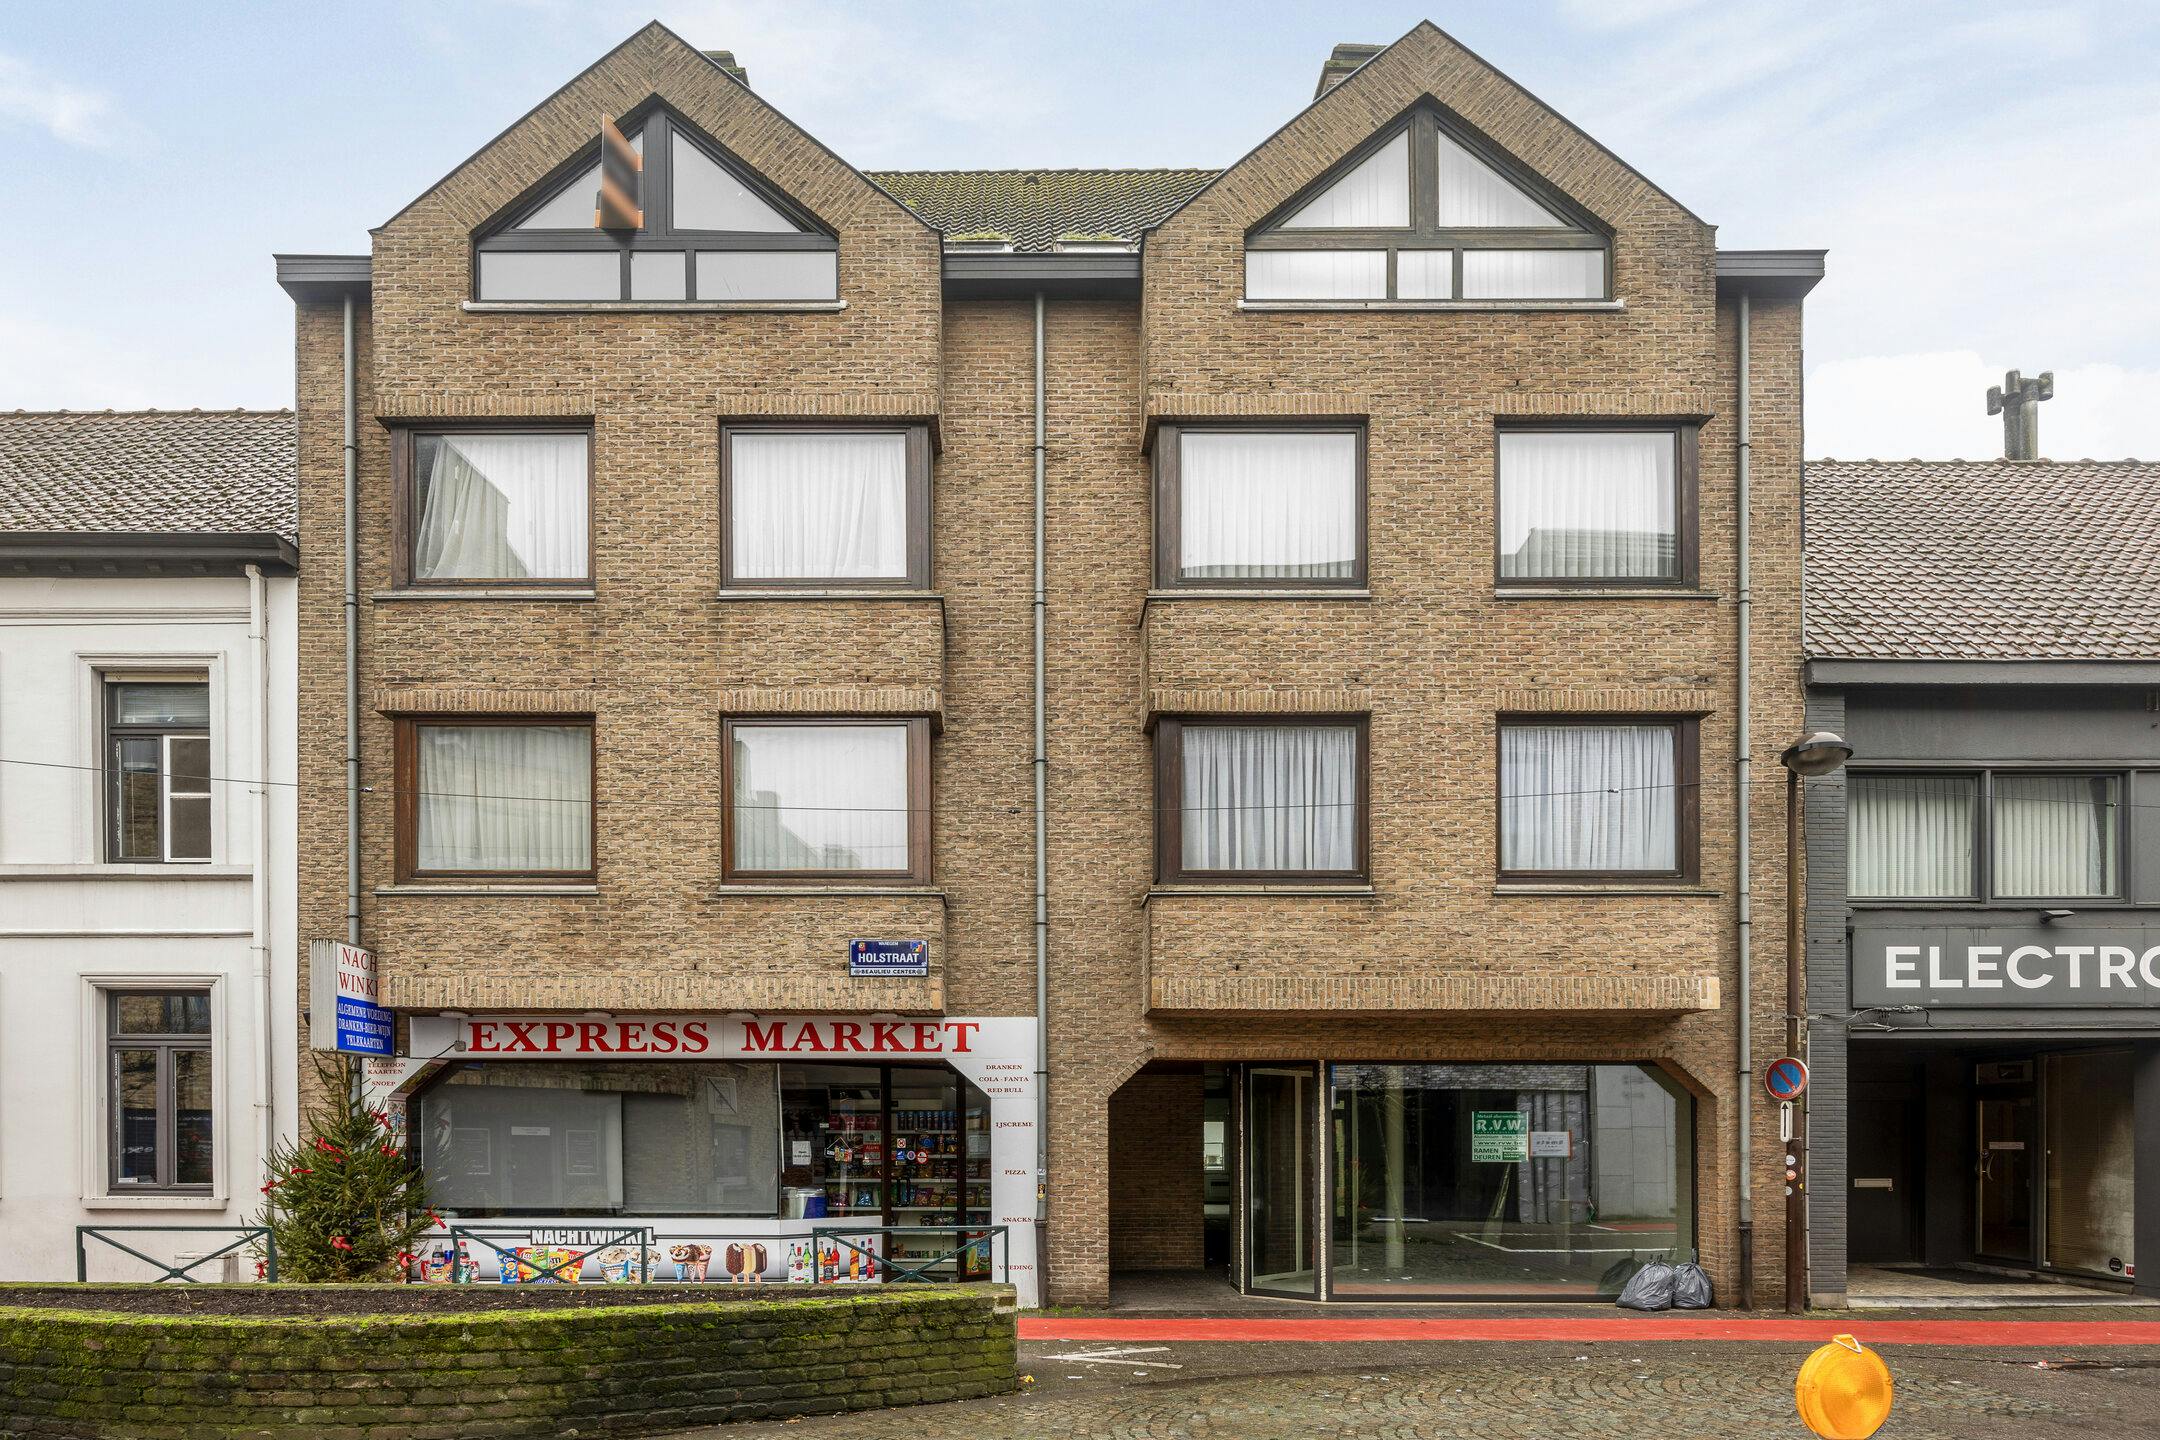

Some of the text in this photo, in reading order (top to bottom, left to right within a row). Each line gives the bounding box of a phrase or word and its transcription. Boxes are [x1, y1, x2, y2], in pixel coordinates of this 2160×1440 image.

[858, 952, 919, 963] HOLSTRAAT
[337, 1003, 392, 1023] ALGEMENE VOEDING
[338, 1018, 392, 1039] DRANKEN-BIER-WIJN
[467, 1021, 980, 1053] EXPRESS MARKET
[345, 1034, 384, 1050] TELEKAARTEN
[995, 1121, 1034, 1129] IJSCREME
